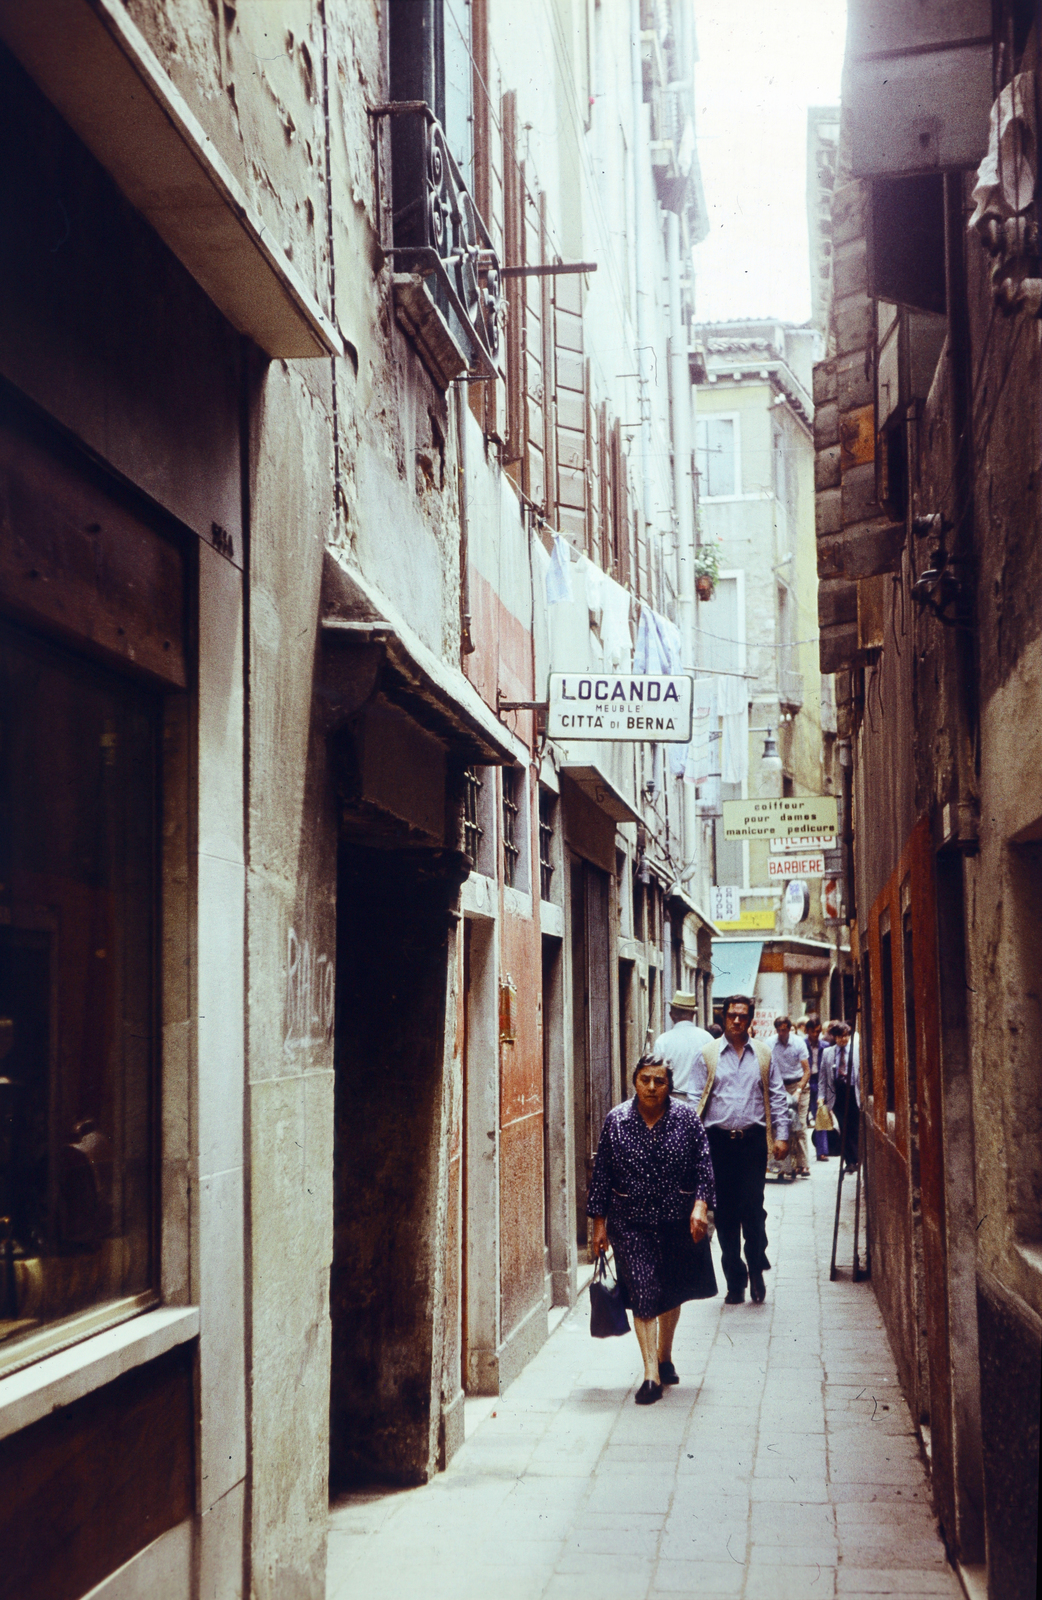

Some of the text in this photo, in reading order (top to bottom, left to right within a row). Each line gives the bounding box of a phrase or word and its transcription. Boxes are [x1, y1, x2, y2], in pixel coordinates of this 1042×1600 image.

[562, 679, 679, 702] LOCANDA
[610, 721, 620, 729] DI
[754, 801, 805, 811] coiffeur
[744, 813, 817, 825] pour dames
[726, 824, 835, 836] manicure pedicure
[769, 859, 824, 875] BARBIERE
